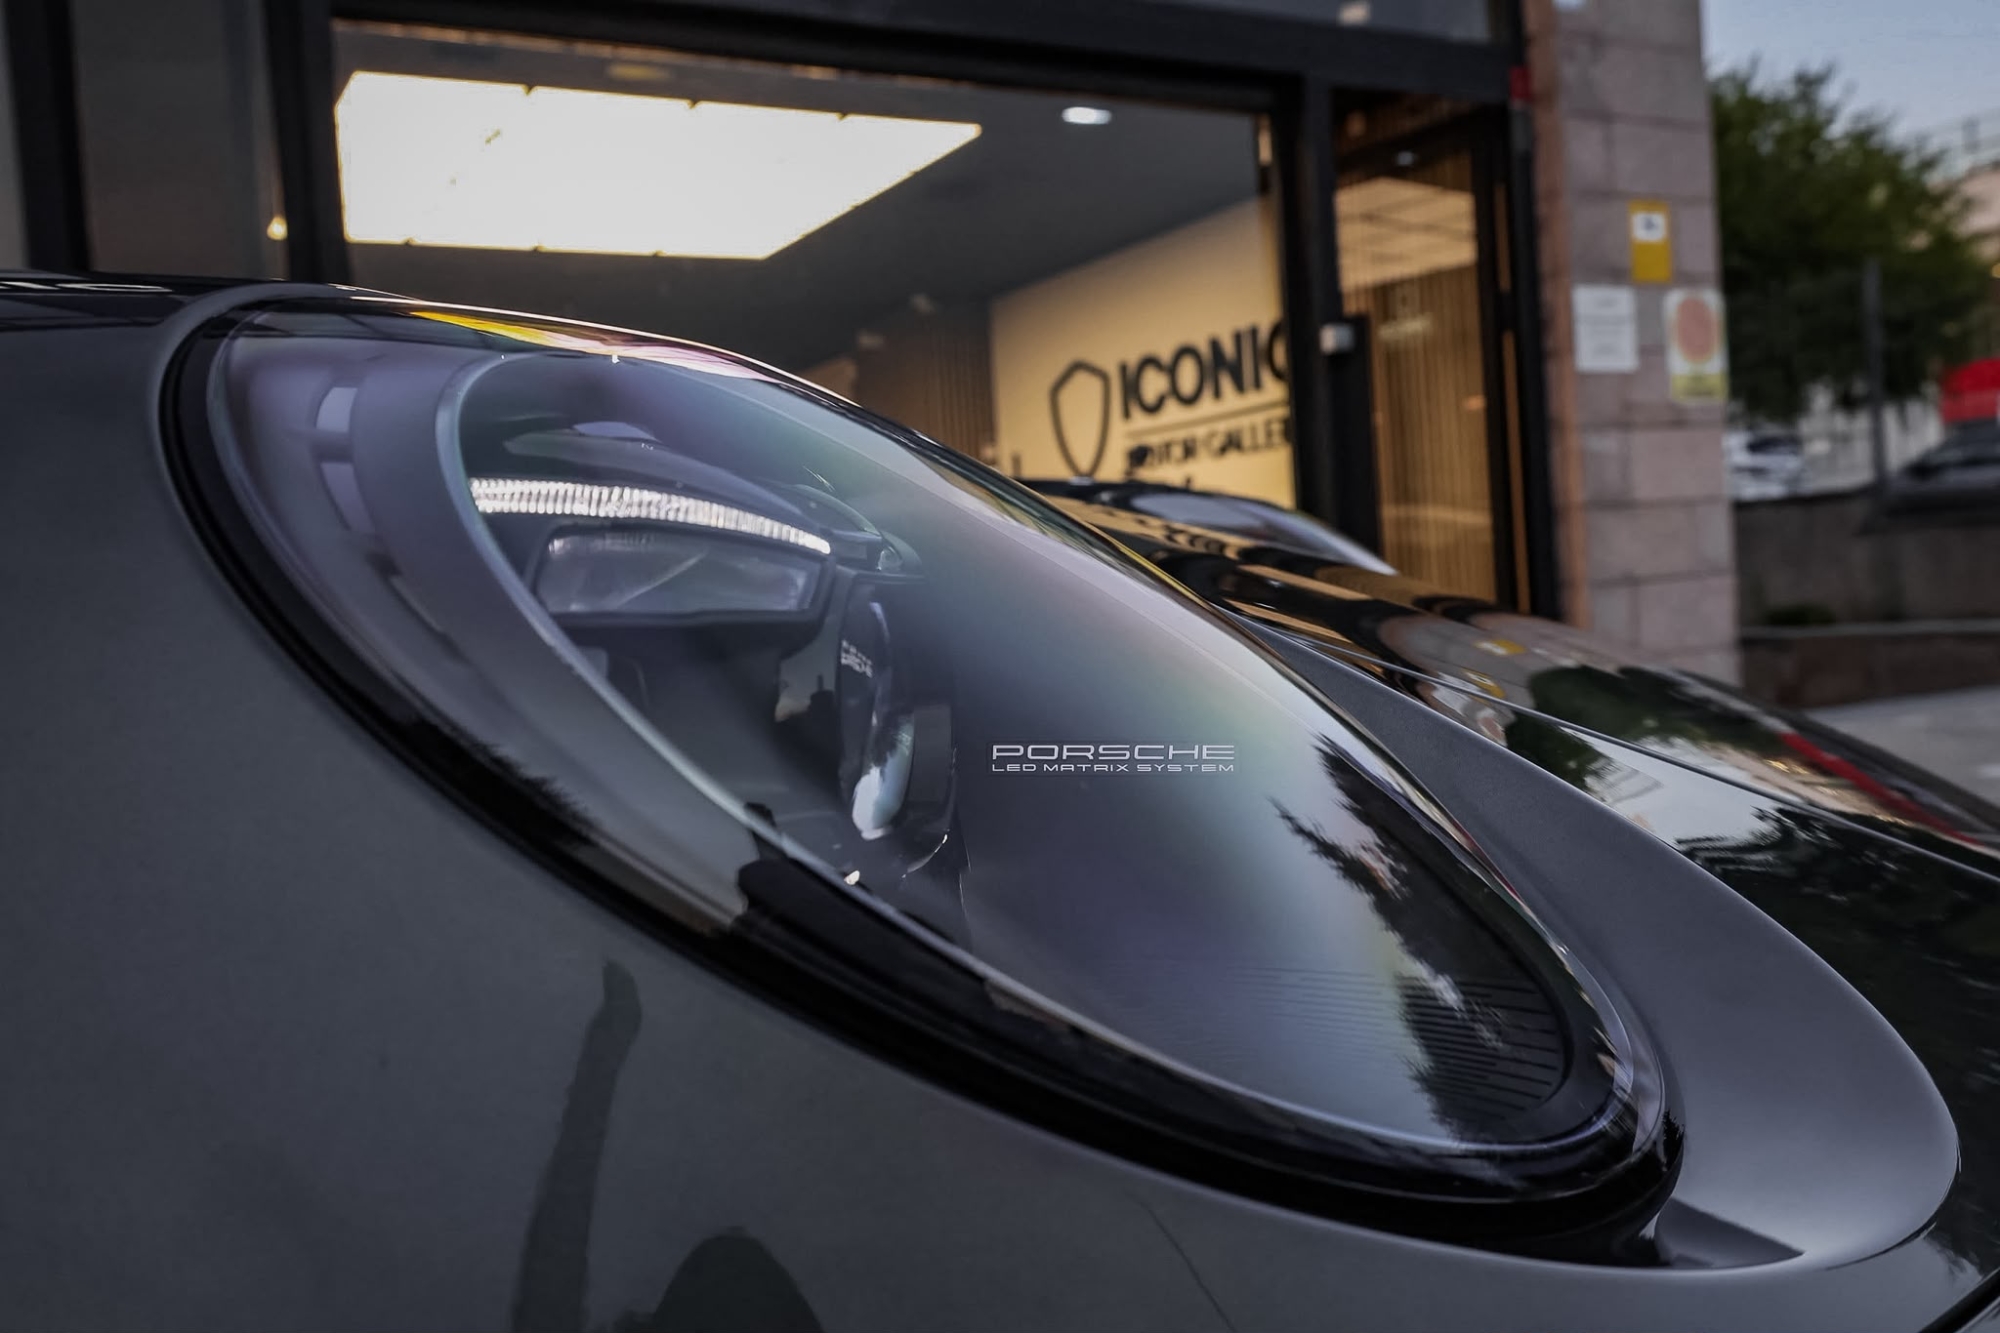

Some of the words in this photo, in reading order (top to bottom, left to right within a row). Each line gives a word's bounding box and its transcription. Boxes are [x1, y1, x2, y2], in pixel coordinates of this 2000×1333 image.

[992, 744, 1235, 760] PORSCHE
[992, 763, 1037, 772] LED
[1043, 763, 1130, 772] MATRIX
[1136, 763, 1235, 772] SYSTEM
